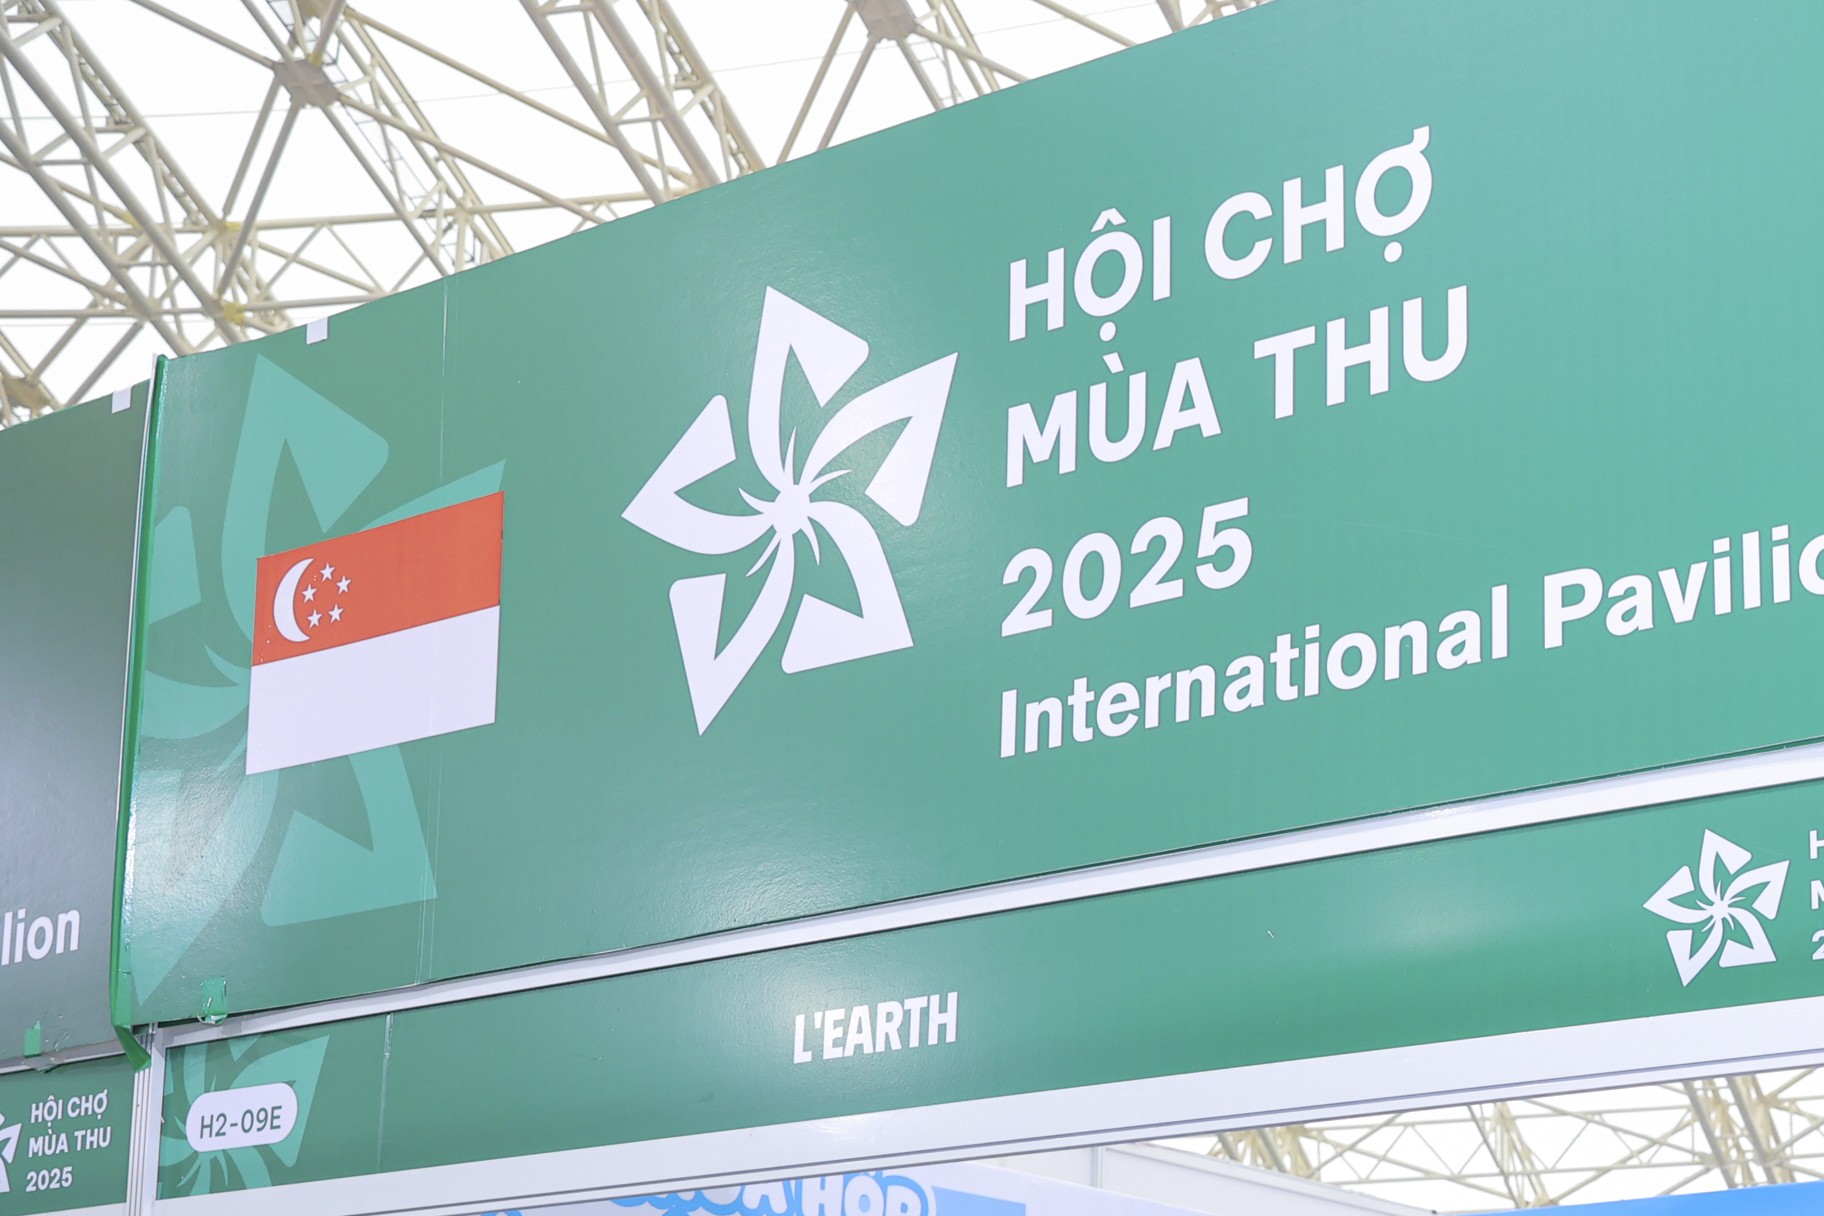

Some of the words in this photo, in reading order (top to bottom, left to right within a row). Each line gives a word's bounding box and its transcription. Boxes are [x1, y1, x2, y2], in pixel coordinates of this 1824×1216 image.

[1007, 207, 1173, 342] HỘI
[1203, 125, 1433, 280] CHỢ
[1005, 352, 1222, 488] MÙA
[1253, 284, 1470, 420] THU
[1000, 497, 1254, 638] 2025
[999, 585, 1510, 760] International
[792, 991, 958, 1065] L'EARTH
[28, 1128, 69, 1158] MÙA
[74, 1126, 111, 1151] THU
[30, 1095, 62, 1127] HỘI
[67, 1089, 108, 1121] CHỢ
[199, 1103, 283, 1142] H2-09E
[26, 1166, 73, 1192] 2025
